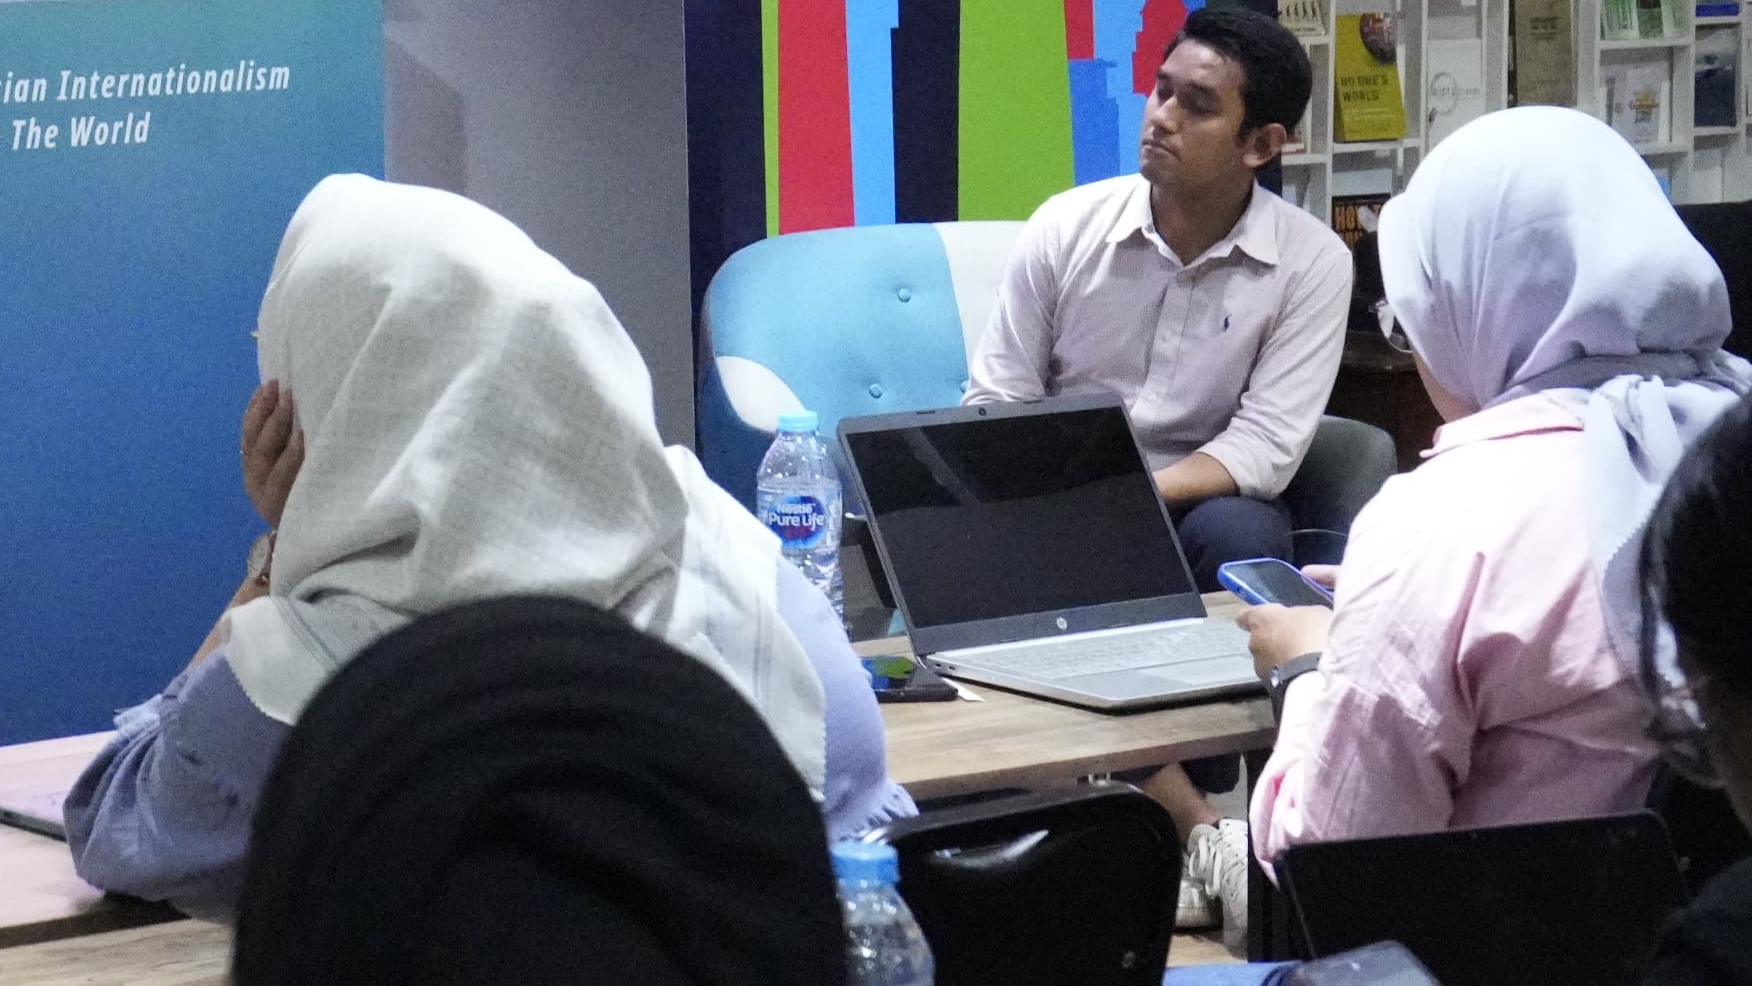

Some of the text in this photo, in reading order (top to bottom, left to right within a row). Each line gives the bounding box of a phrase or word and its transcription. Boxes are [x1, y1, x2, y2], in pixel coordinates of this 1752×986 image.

[56, 60, 291, 102] Internationalism
[12, 117, 59, 151] The
[70, 110, 151, 147] World
[768, 513, 825, 532] Pure Life
